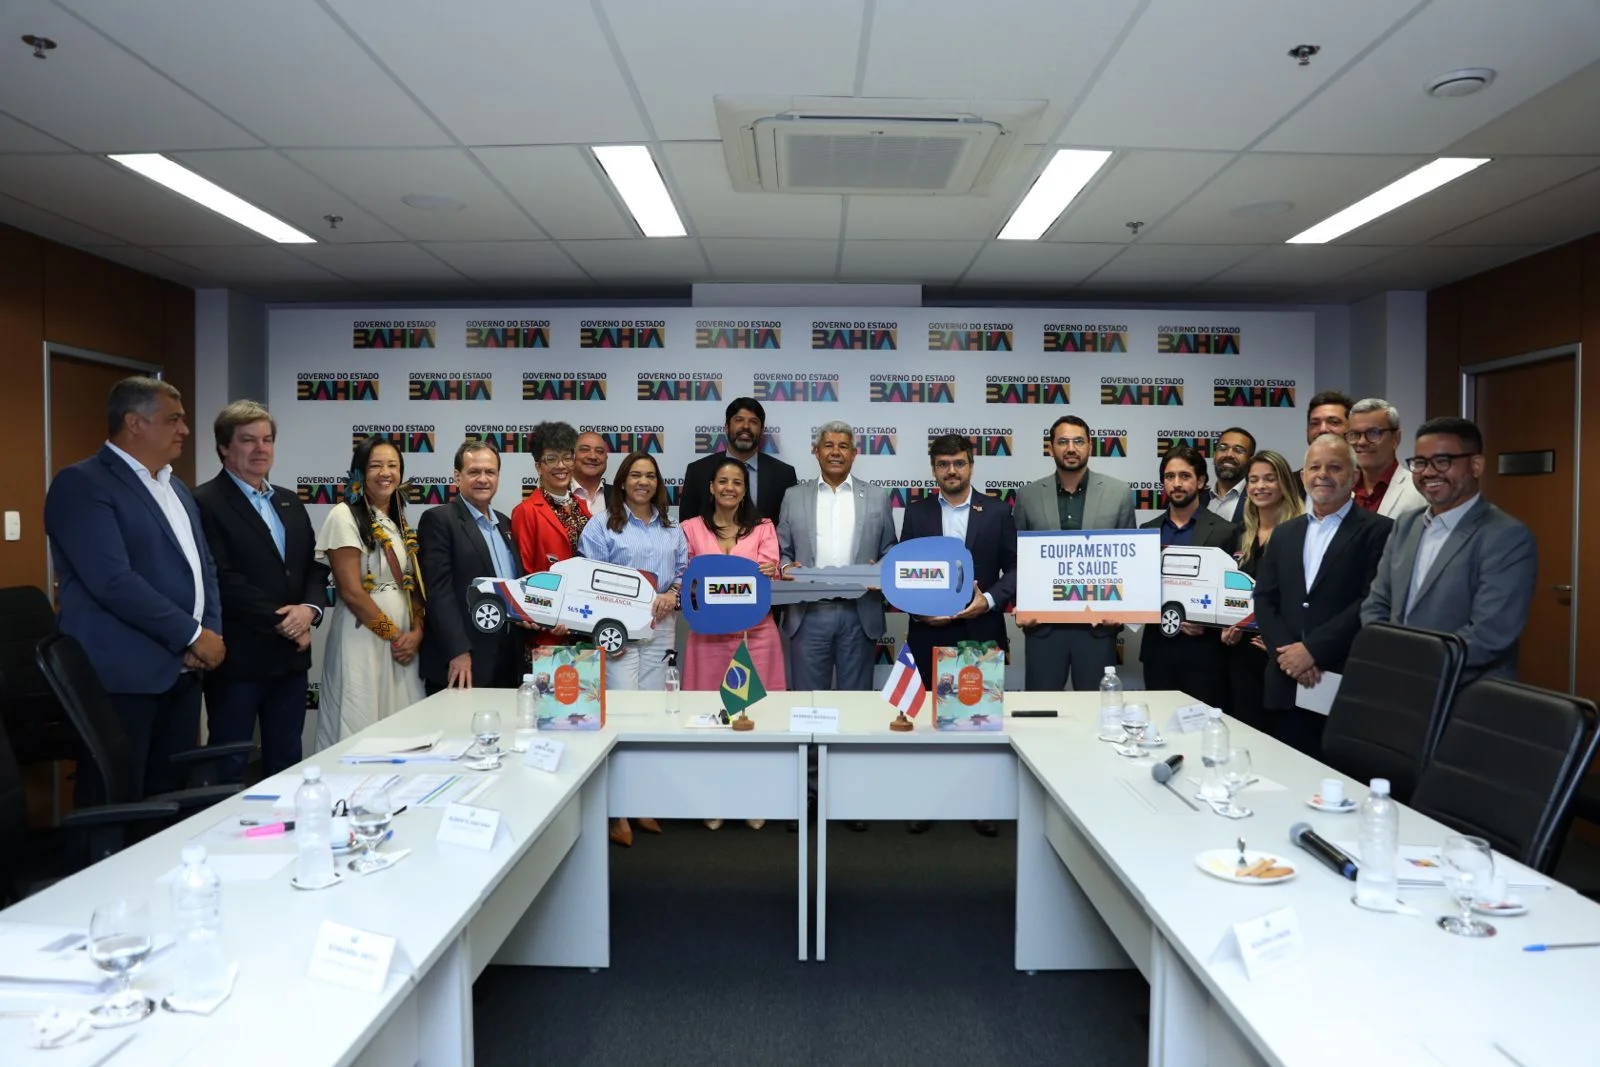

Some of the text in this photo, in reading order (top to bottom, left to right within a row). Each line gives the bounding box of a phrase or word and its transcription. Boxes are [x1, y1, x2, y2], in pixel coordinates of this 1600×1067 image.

[353, 328, 436, 348] BAHIA
[466, 328, 550, 348] BAHIA
[580, 328, 665, 348] BAHIA
[1044, 324, 1128, 332] GOVERNO DO ESTADO
[1158, 325, 1240, 334] GOVERNO DO ESTADO
[696, 328, 781, 349] BAHIA
[812, 330, 897, 350] BAHIA
[928, 330, 1013, 352] BAHIA
[1044, 332, 1128, 352] BAHIA
[1158, 334, 1240, 355] BAHIA
[297, 380, 379, 400] BAHIA
[409, 380, 492, 400] BAHIA
[522, 380, 607, 400] BAHIA
[1101, 376, 1184, 384] GOVERNO DO ESTADO
[1214, 378, 1296, 386] GOVERNO DO ESTADO
[638, 380, 722, 401] BAHIA
[754, 382, 839, 402] BAHIA
[870, 382, 955, 403] BAHIA
[986, 384, 1070, 404] BAHIA
[1101, 385, 1184, 406] BAHIA
[1214, 387, 1296, 408] BAHIA
[602, 433, 664, 453] AHIA
[1040, 543, 1136, 558] EQUIPAMENTOS
[1058, 560, 1118, 576] DE SAÚDE
[1053, 584, 1122, 600] BAHIA
